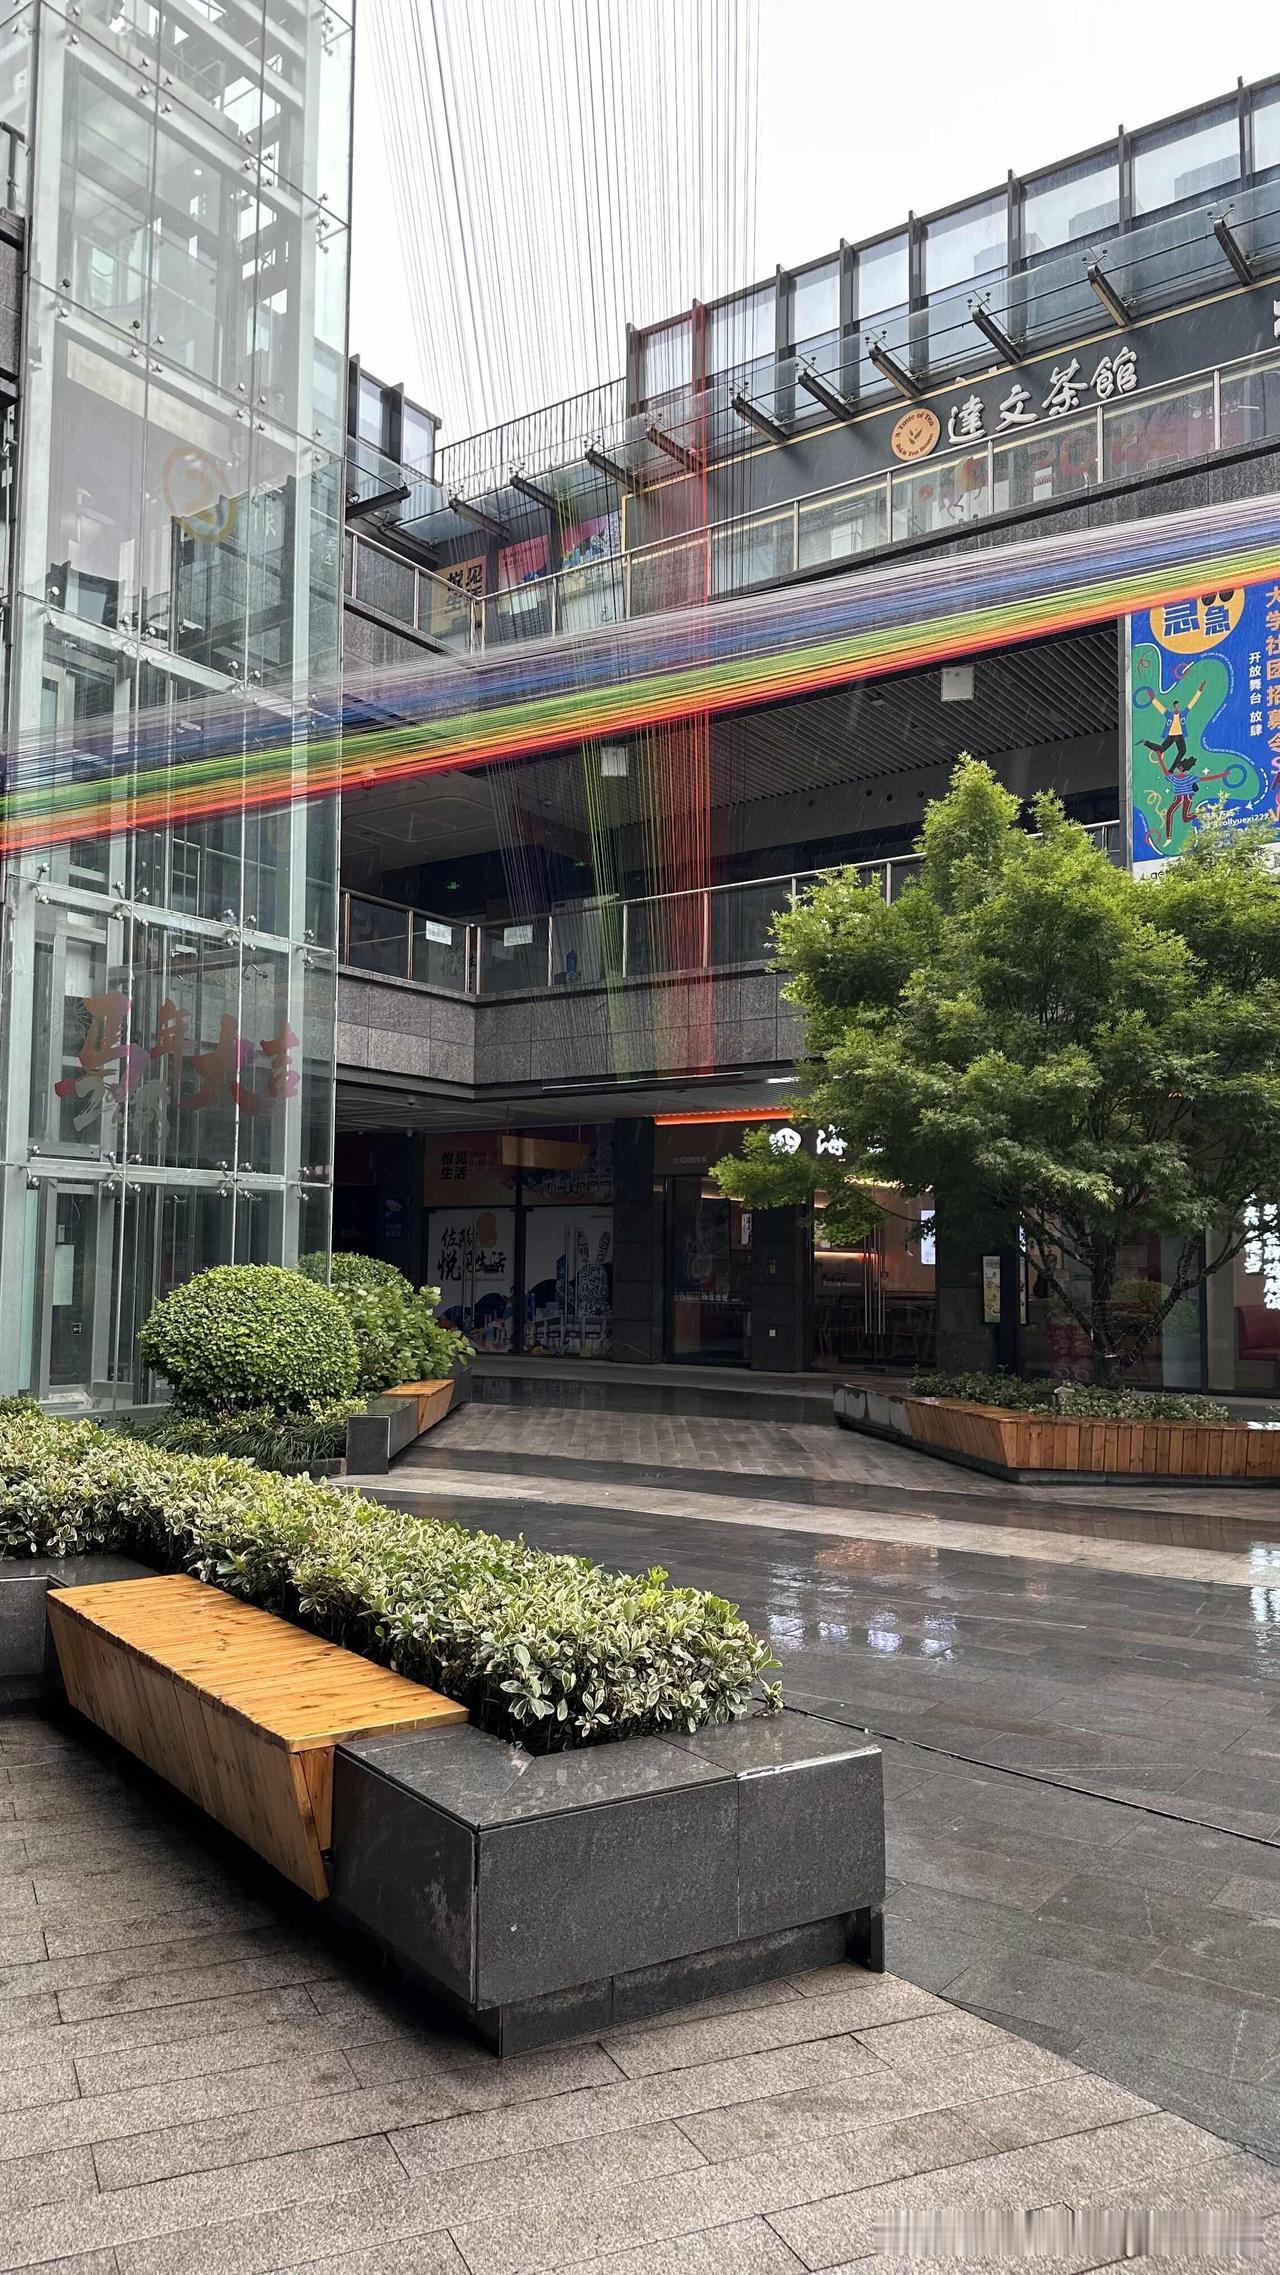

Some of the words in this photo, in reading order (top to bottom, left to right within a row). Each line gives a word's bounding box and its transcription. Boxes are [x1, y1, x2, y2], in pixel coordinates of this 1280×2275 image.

[948, 345, 1139, 446] 達文茶館
[1248, 651, 1262, 705] 开放舞台
